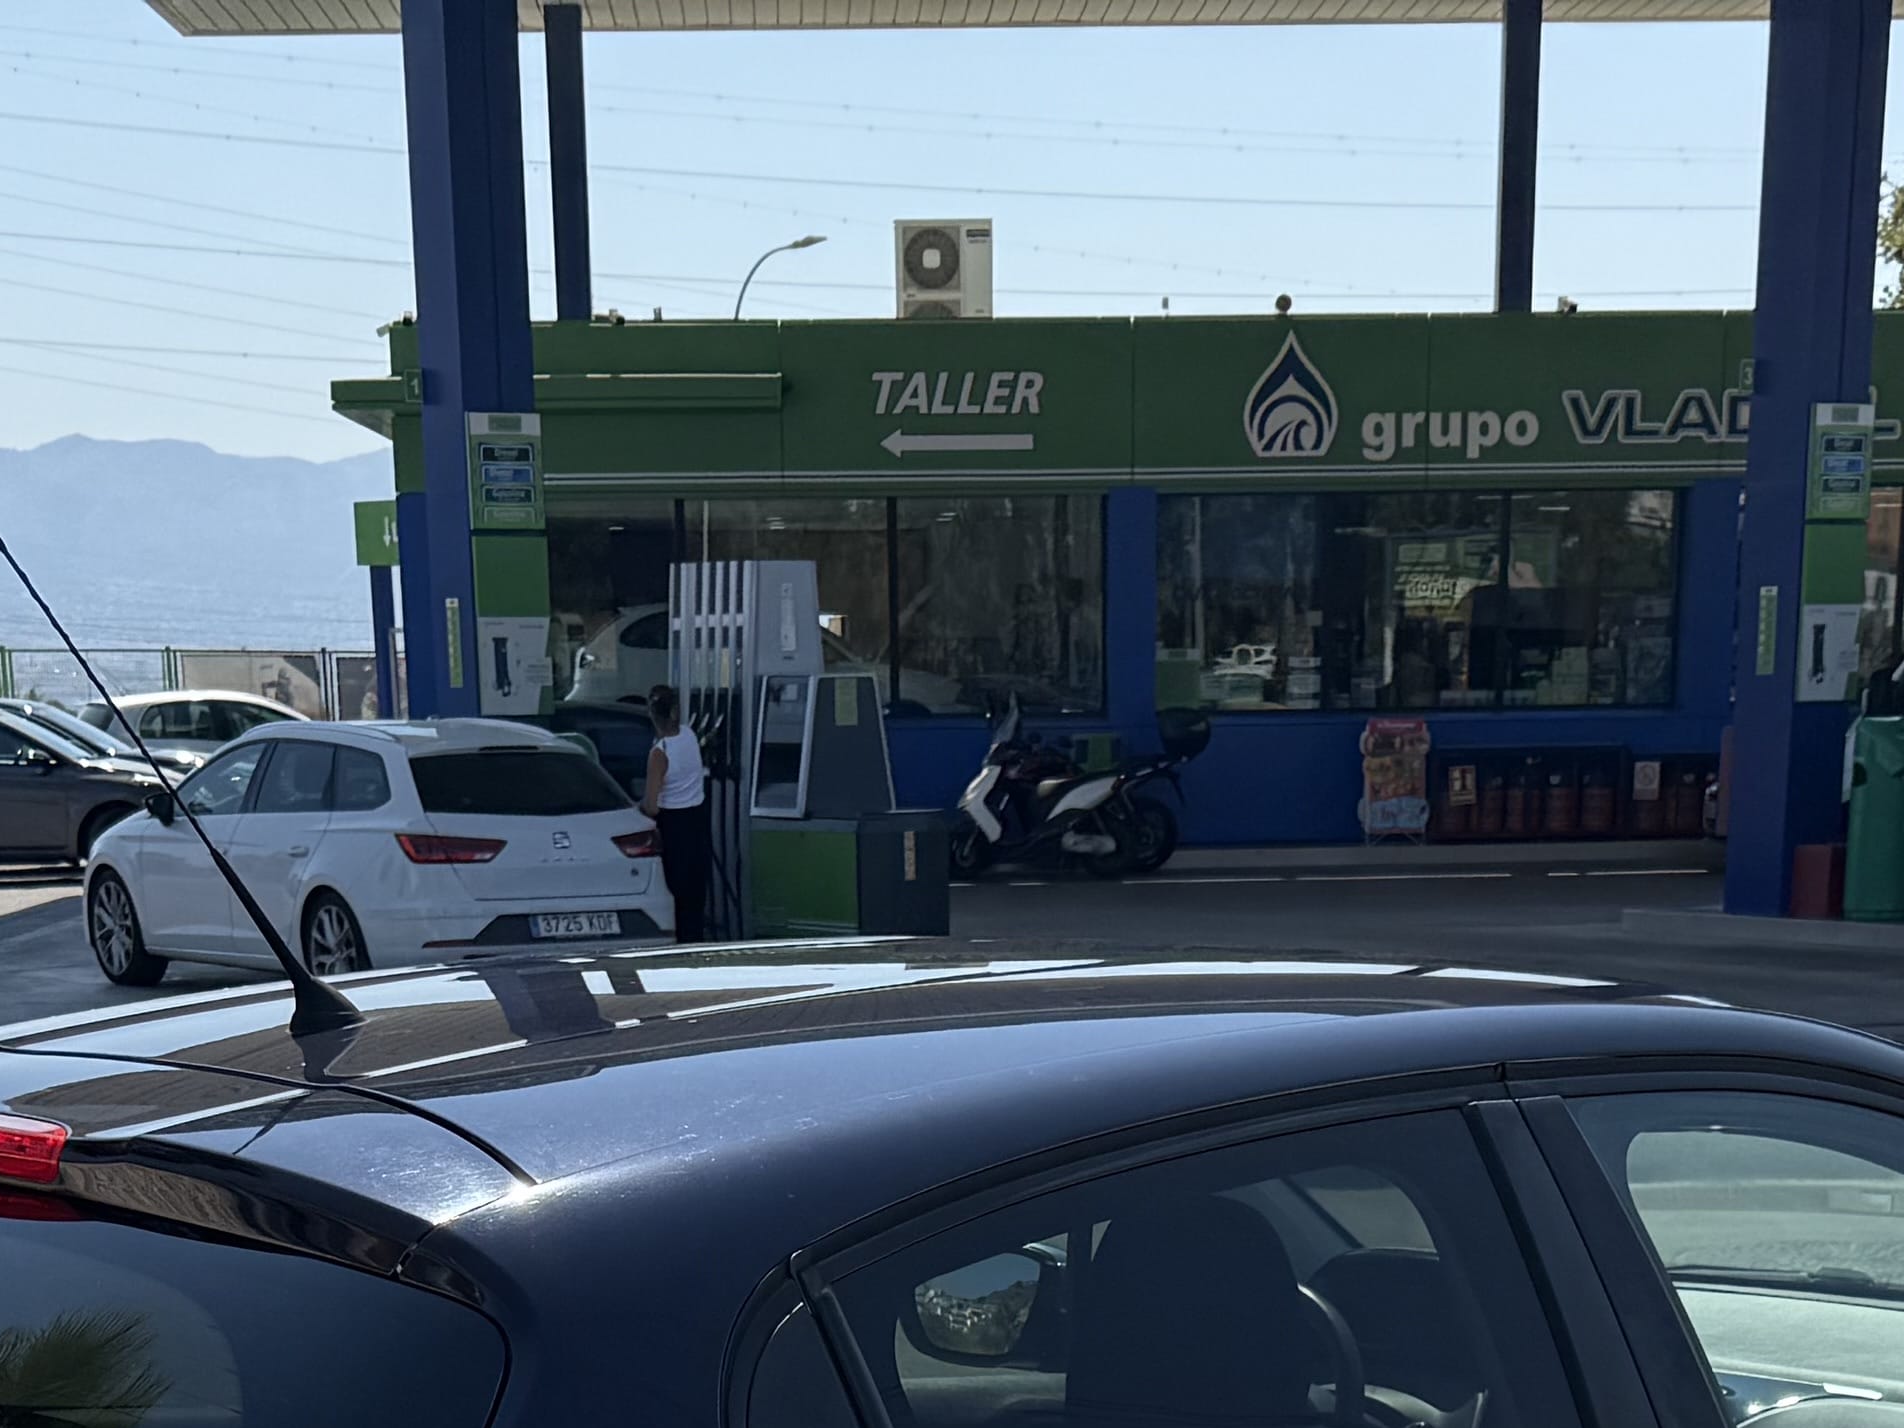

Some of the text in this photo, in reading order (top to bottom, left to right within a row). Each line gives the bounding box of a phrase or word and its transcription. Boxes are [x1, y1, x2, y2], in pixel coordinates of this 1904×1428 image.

[1744, 367, 1753, 385] 3
[411, 377, 420, 395] 1
[872, 371, 1044, 416] TALLER
[1361, 407, 1540, 462] grupo
[542, 915, 583, 933] 3725
